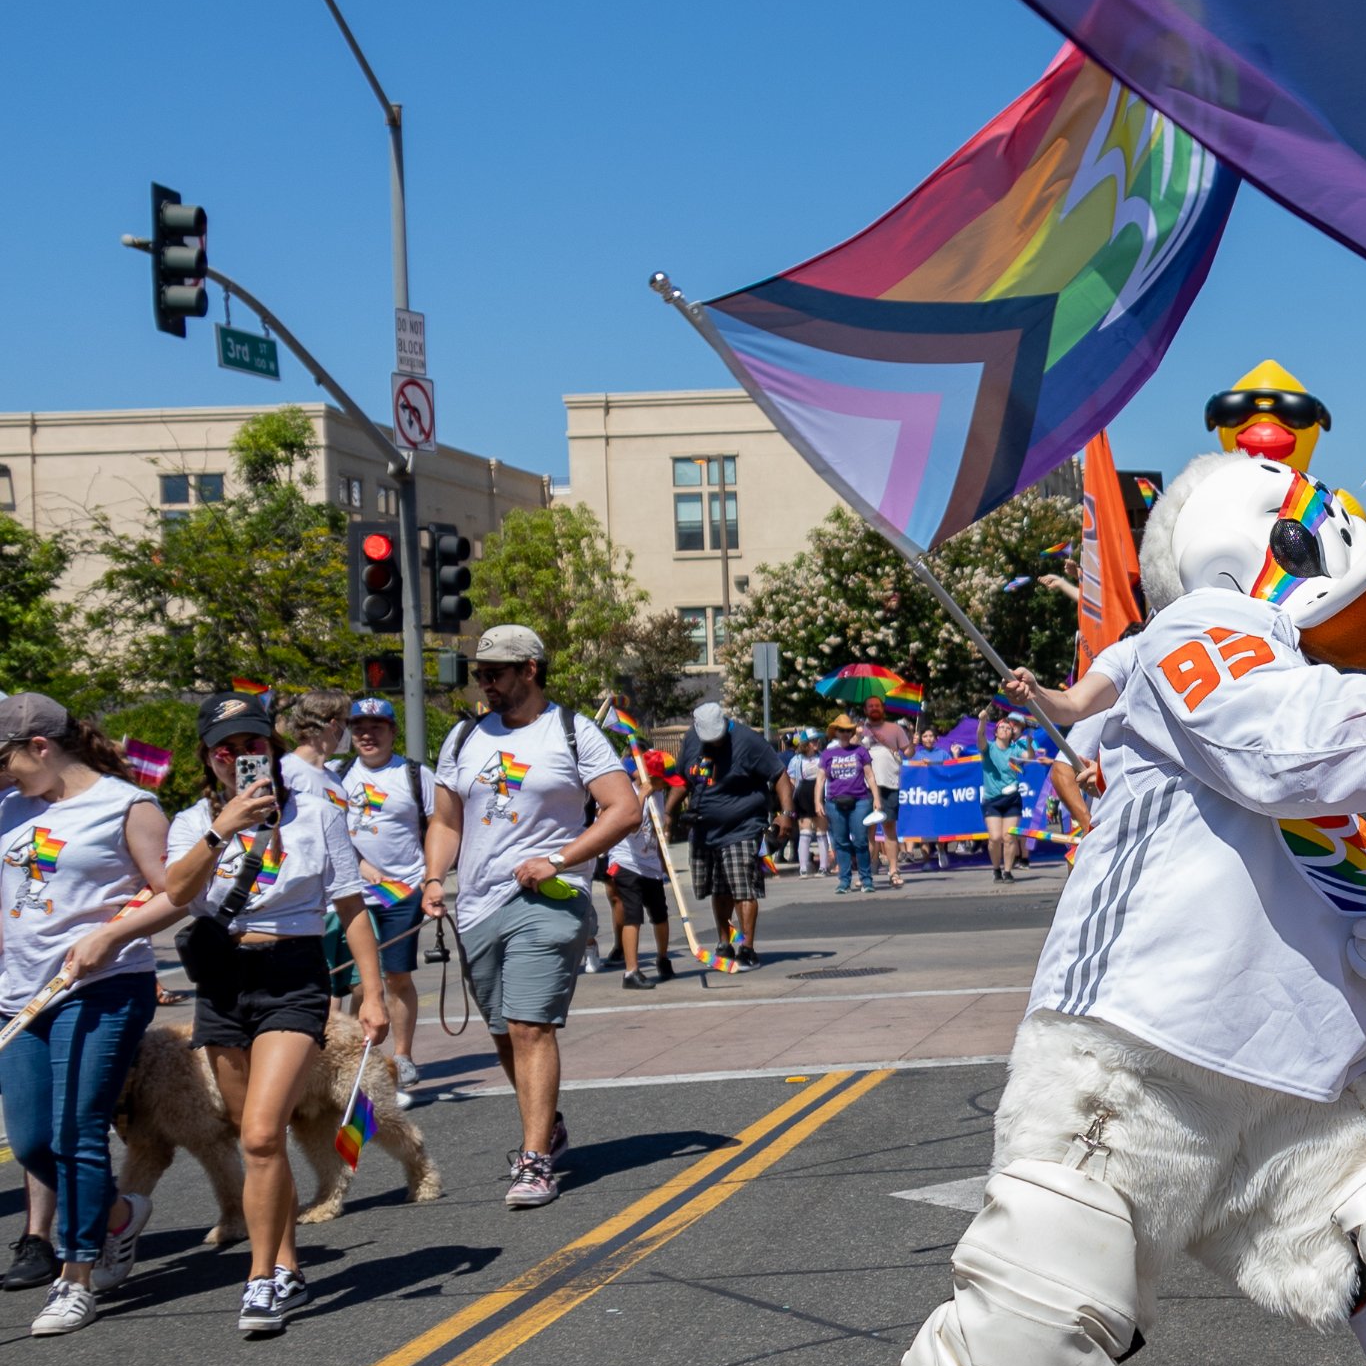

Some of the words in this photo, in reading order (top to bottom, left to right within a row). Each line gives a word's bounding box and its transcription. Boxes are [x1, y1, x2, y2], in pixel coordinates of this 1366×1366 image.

[398, 317, 406, 332] DO
[409, 319, 422, 335] NOT
[226, 336, 250, 363] 3rd
[397, 337, 423, 355] BLOCK
[952, 786, 976, 803] we
